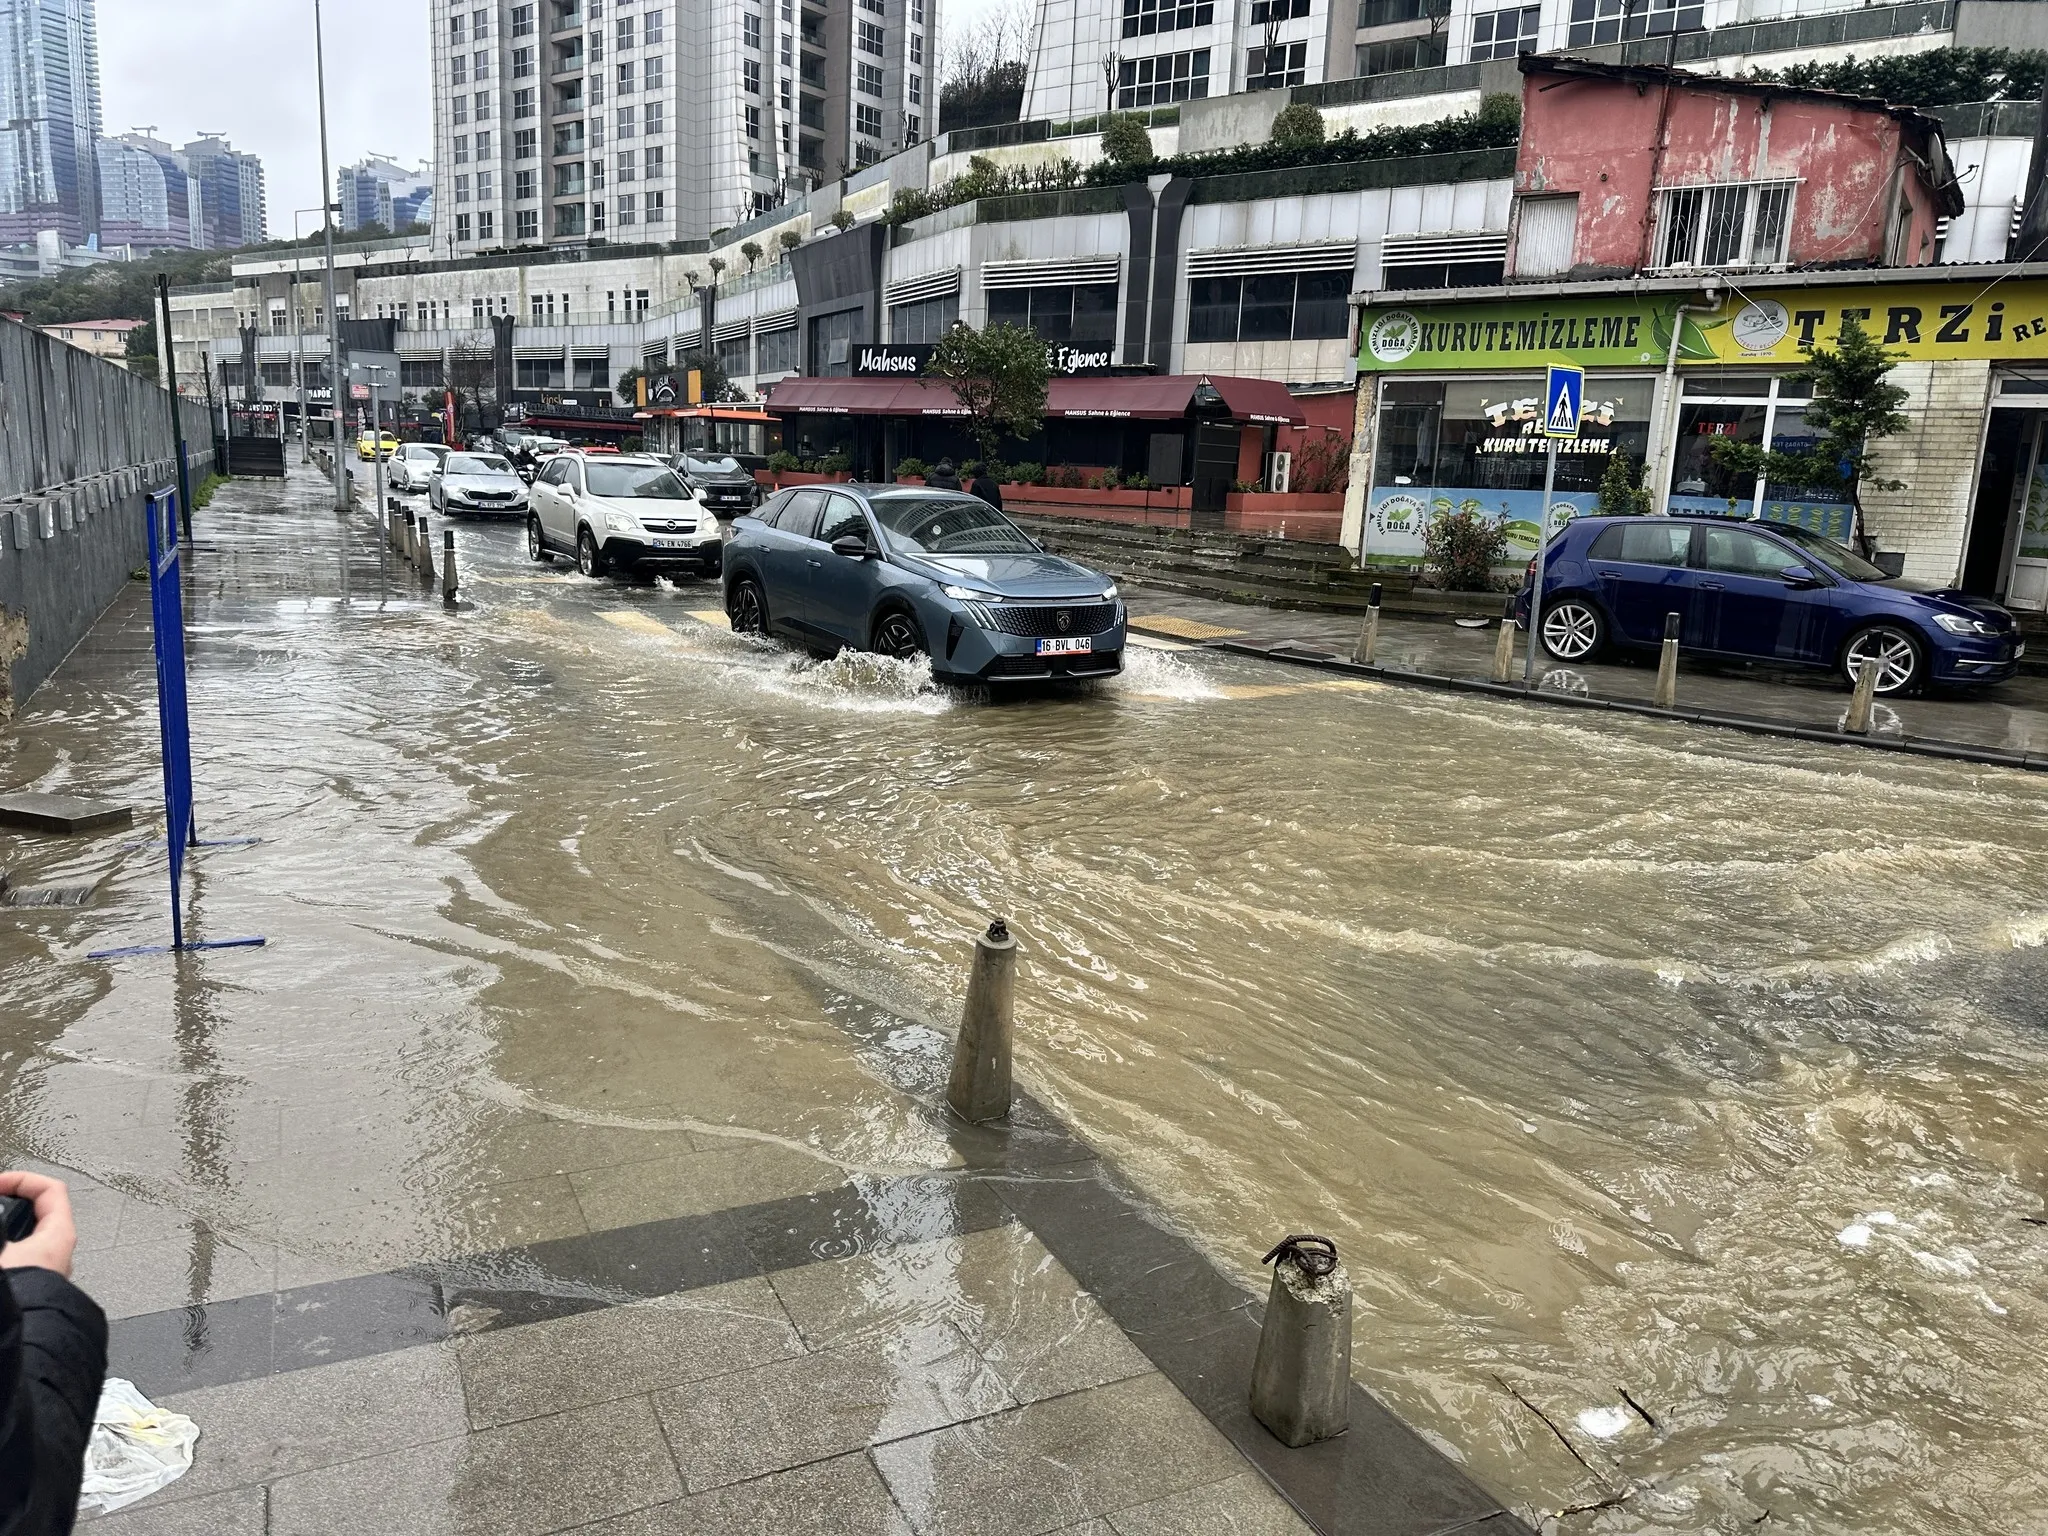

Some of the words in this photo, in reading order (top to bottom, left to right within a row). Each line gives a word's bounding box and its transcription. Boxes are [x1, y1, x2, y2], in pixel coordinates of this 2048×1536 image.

[1420, 311, 1641, 352] KURUTEMİZLEME
[859, 347, 917, 372] Mahsus
[1057, 346, 1108, 374] Eğlence
[1042, 640, 1051, 652] 16
[1055, 639, 1071, 651] BVL
[1075, 638, 1090, 650] 046
